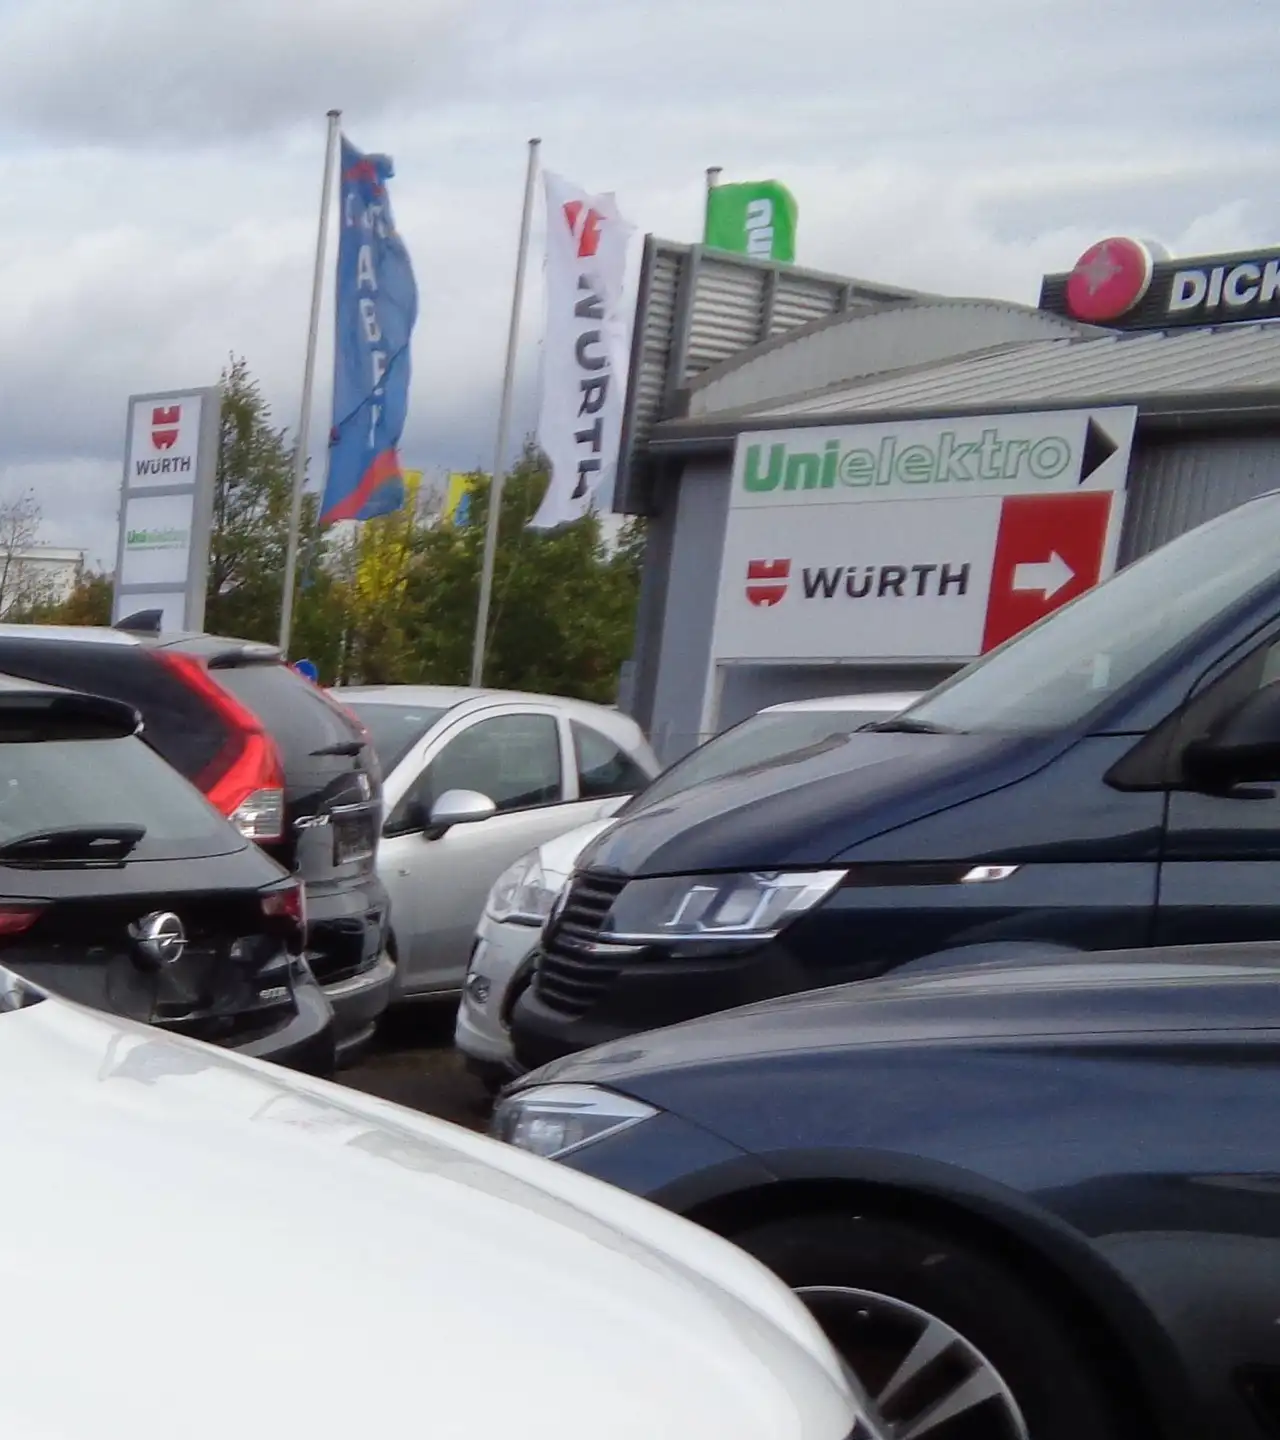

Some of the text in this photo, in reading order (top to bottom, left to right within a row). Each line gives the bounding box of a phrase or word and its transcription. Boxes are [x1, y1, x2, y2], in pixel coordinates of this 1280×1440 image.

[136, 456, 191, 475] WÜRTH
[744, 429, 1071, 492] Unielektro
[802, 563, 970, 600] WÜRTH
